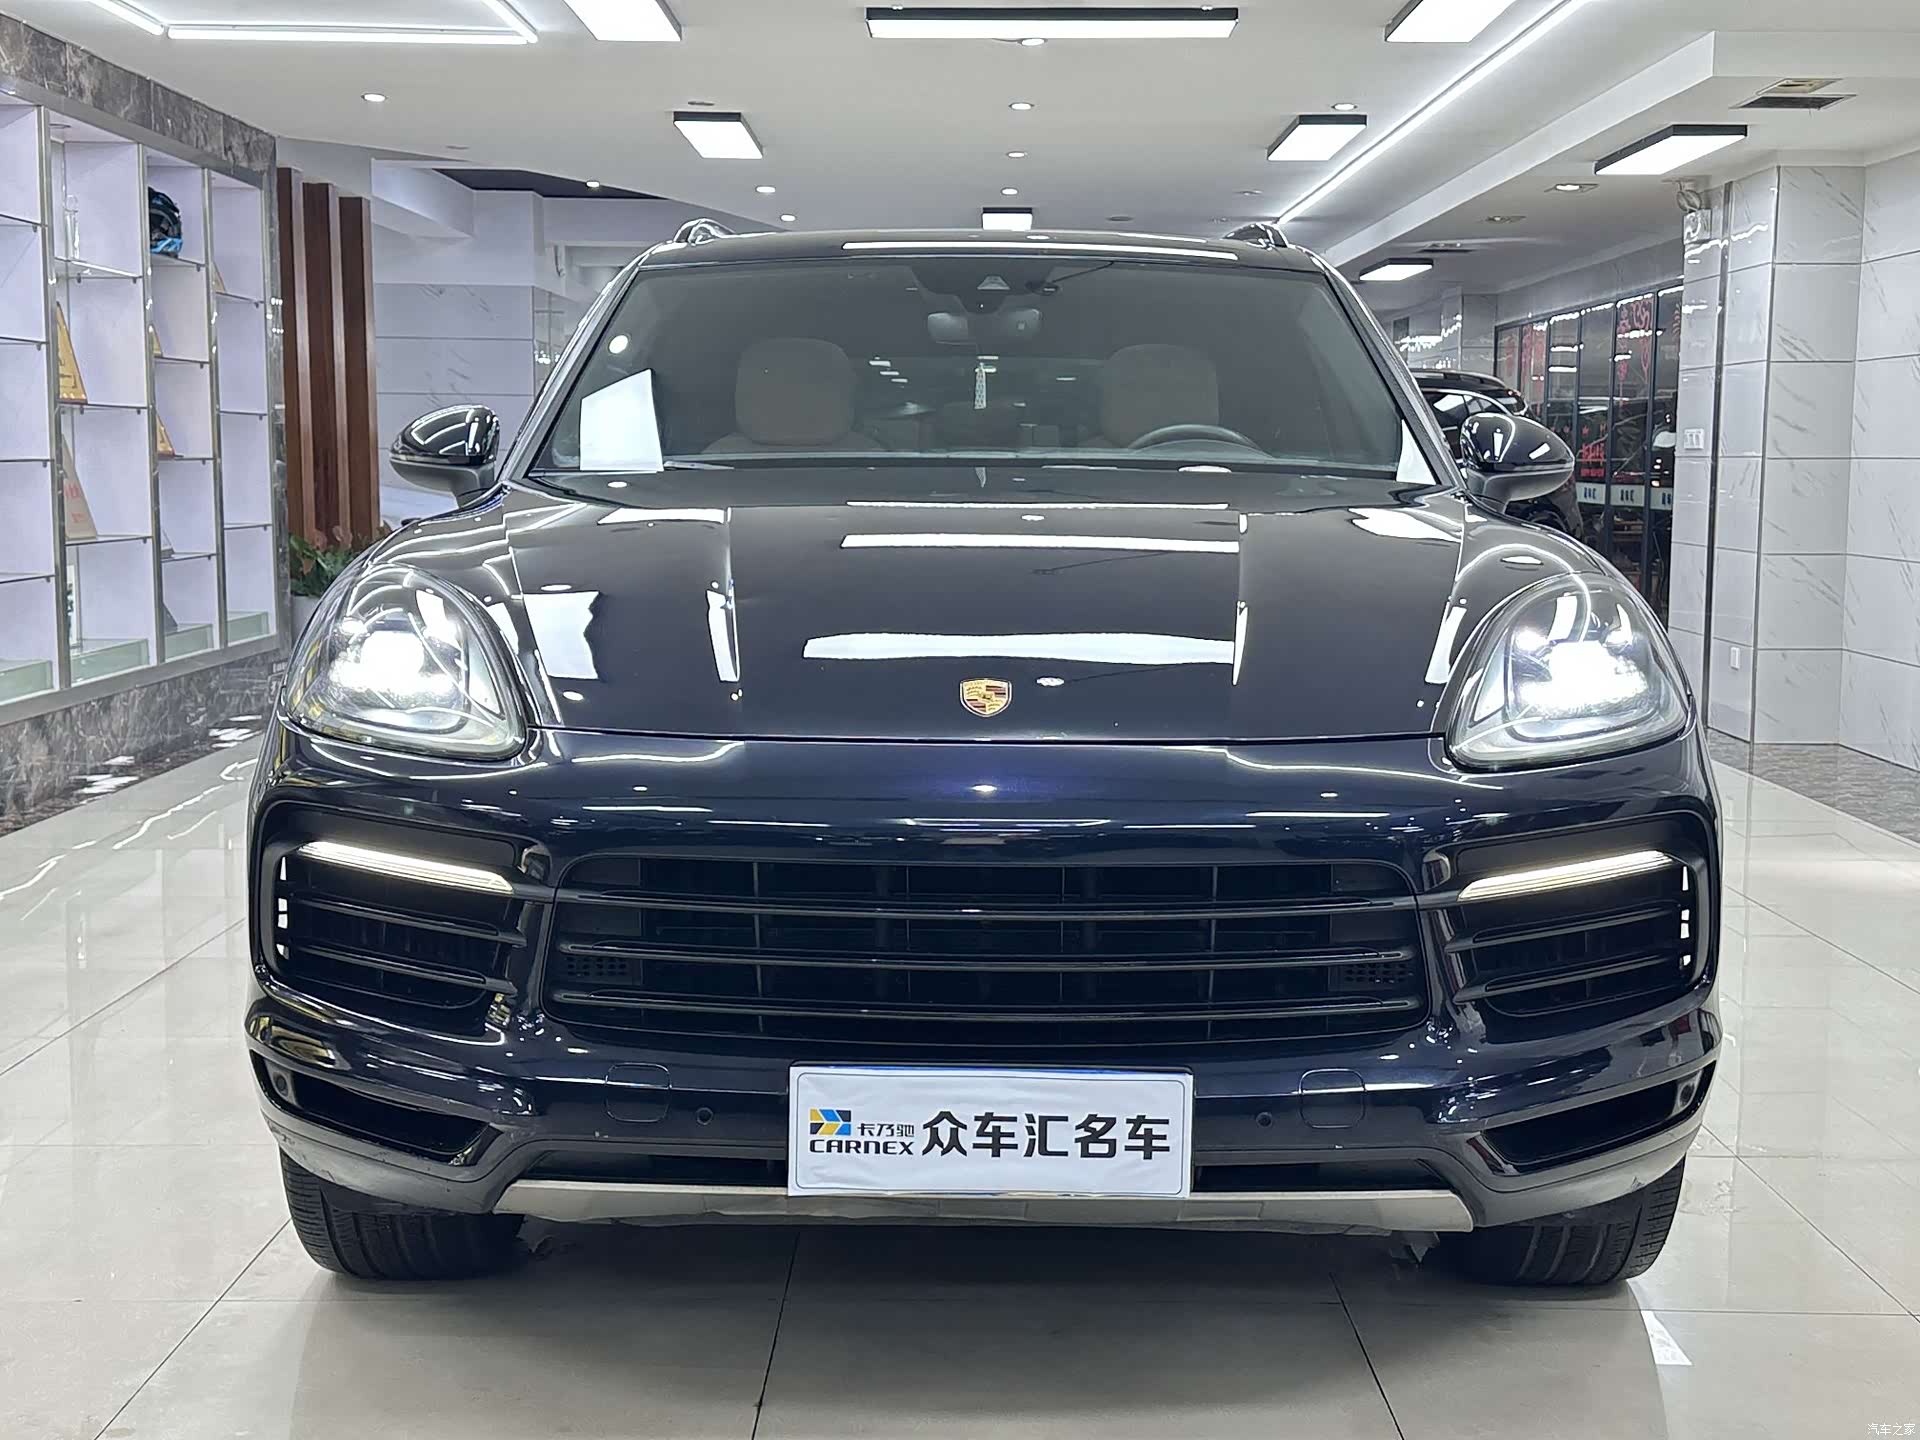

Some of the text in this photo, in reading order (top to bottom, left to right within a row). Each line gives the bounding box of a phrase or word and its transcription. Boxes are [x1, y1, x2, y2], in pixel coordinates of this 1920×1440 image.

[857, 1123, 915, 1138] 卡乃驰
[922, 1110, 1171, 1160] 众车汇名车
[809, 1139, 914, 1156] CARNEX
